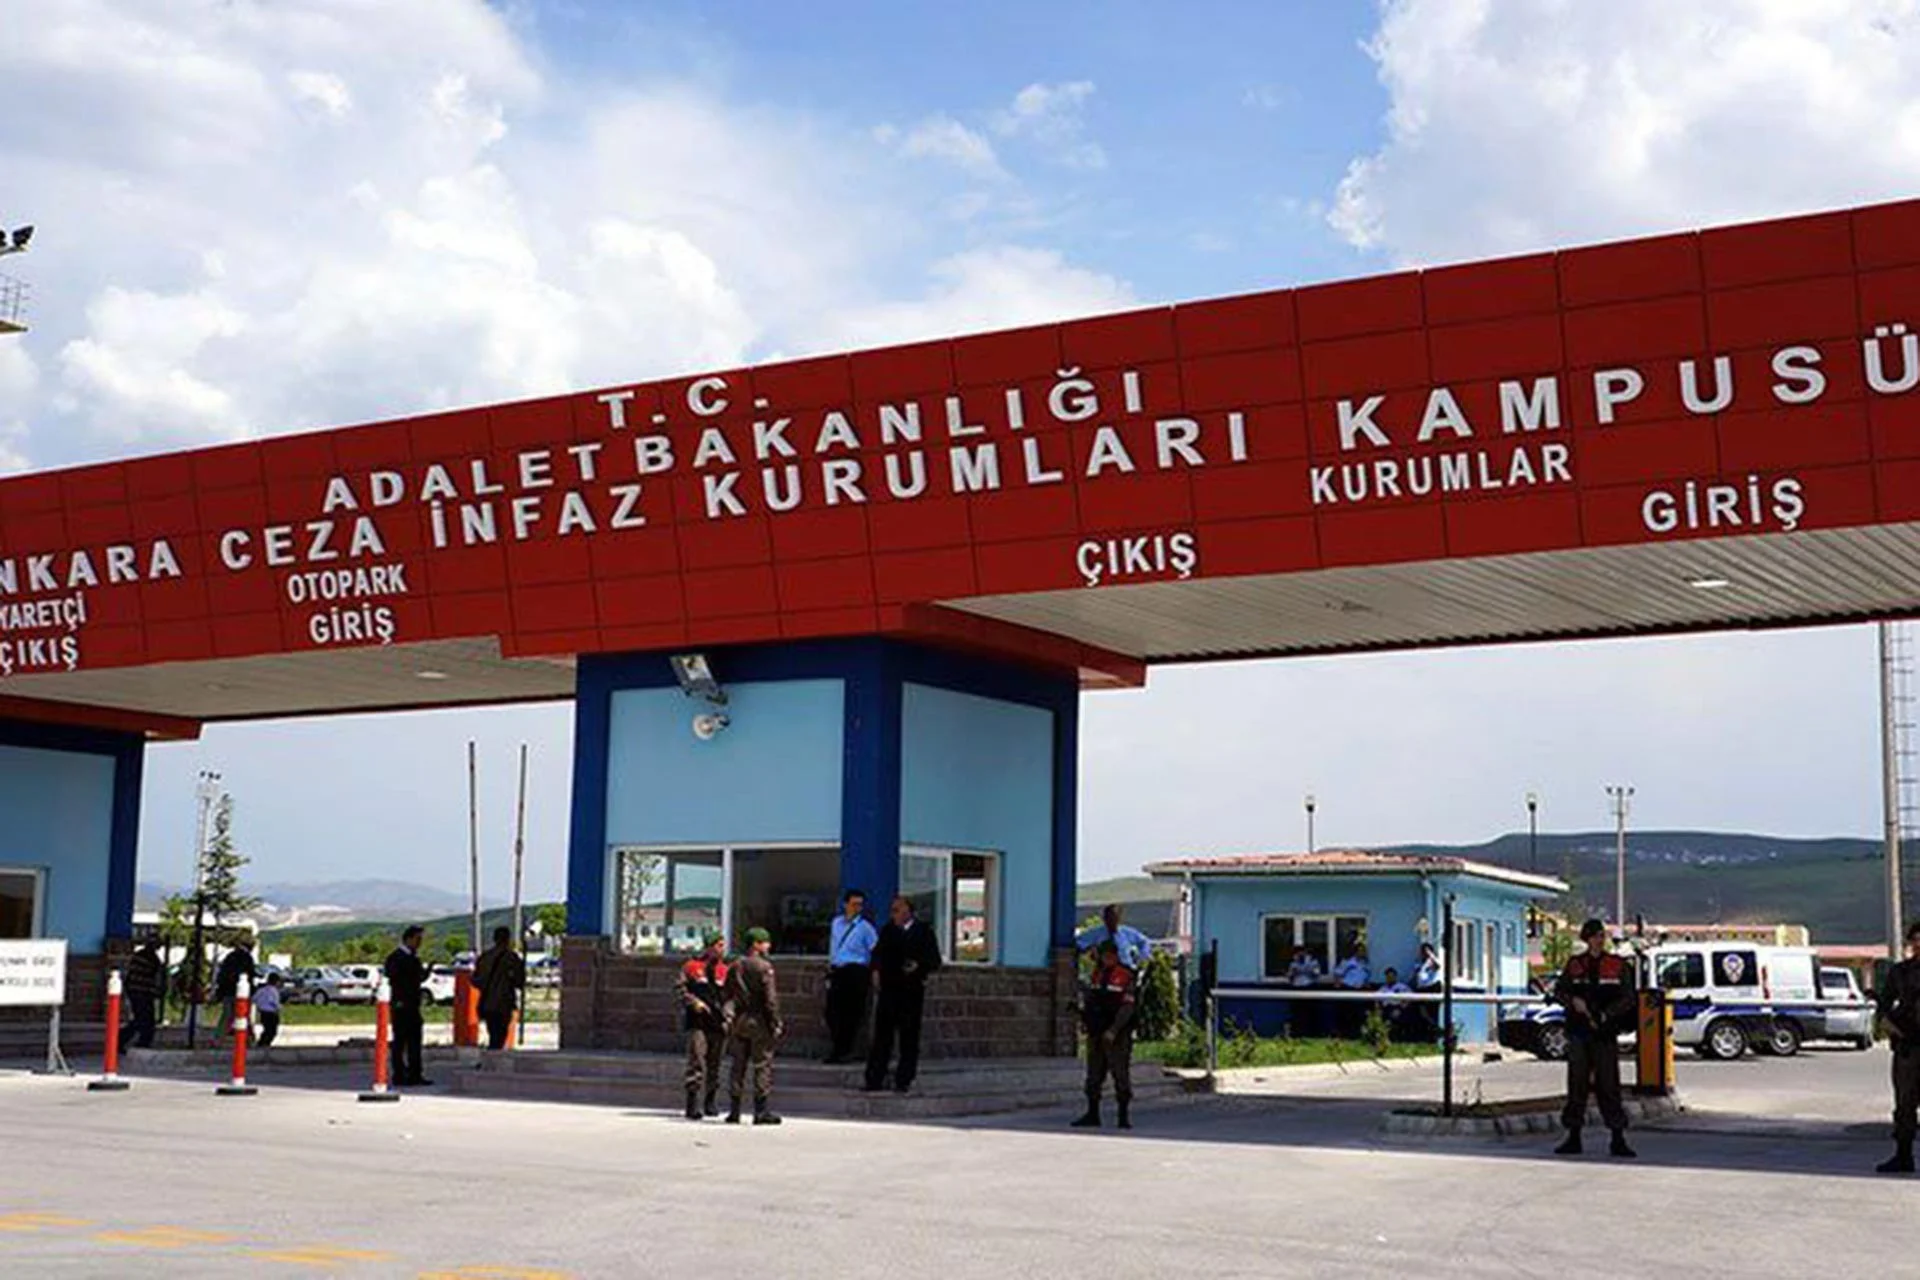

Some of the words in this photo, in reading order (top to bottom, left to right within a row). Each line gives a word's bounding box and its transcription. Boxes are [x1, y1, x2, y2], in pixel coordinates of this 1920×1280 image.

[220, 516, 385, 569] CEZA
[430, 484, 646, 548] İNFAZ
[703, 412, 1247, 518] KURUMLARI
[1336, 323, 1919, 450] KAMPUSÜ
[322, 443, 602, 513] ADALET
[634, 366, 1142, 474] BAKANLIĞI
[1310, 443, 1572, 504] KURUMLAR
[1642, 475, 1804, 531] GİRİŞ
[287, 563, 407, 603] OTOPARK
[1076, 533, 1196, 588] ÇIKIŞ
[309, 601, 394, 646] GİRİŞ
[0, 635, 79, 676] ÇIKIŞ
